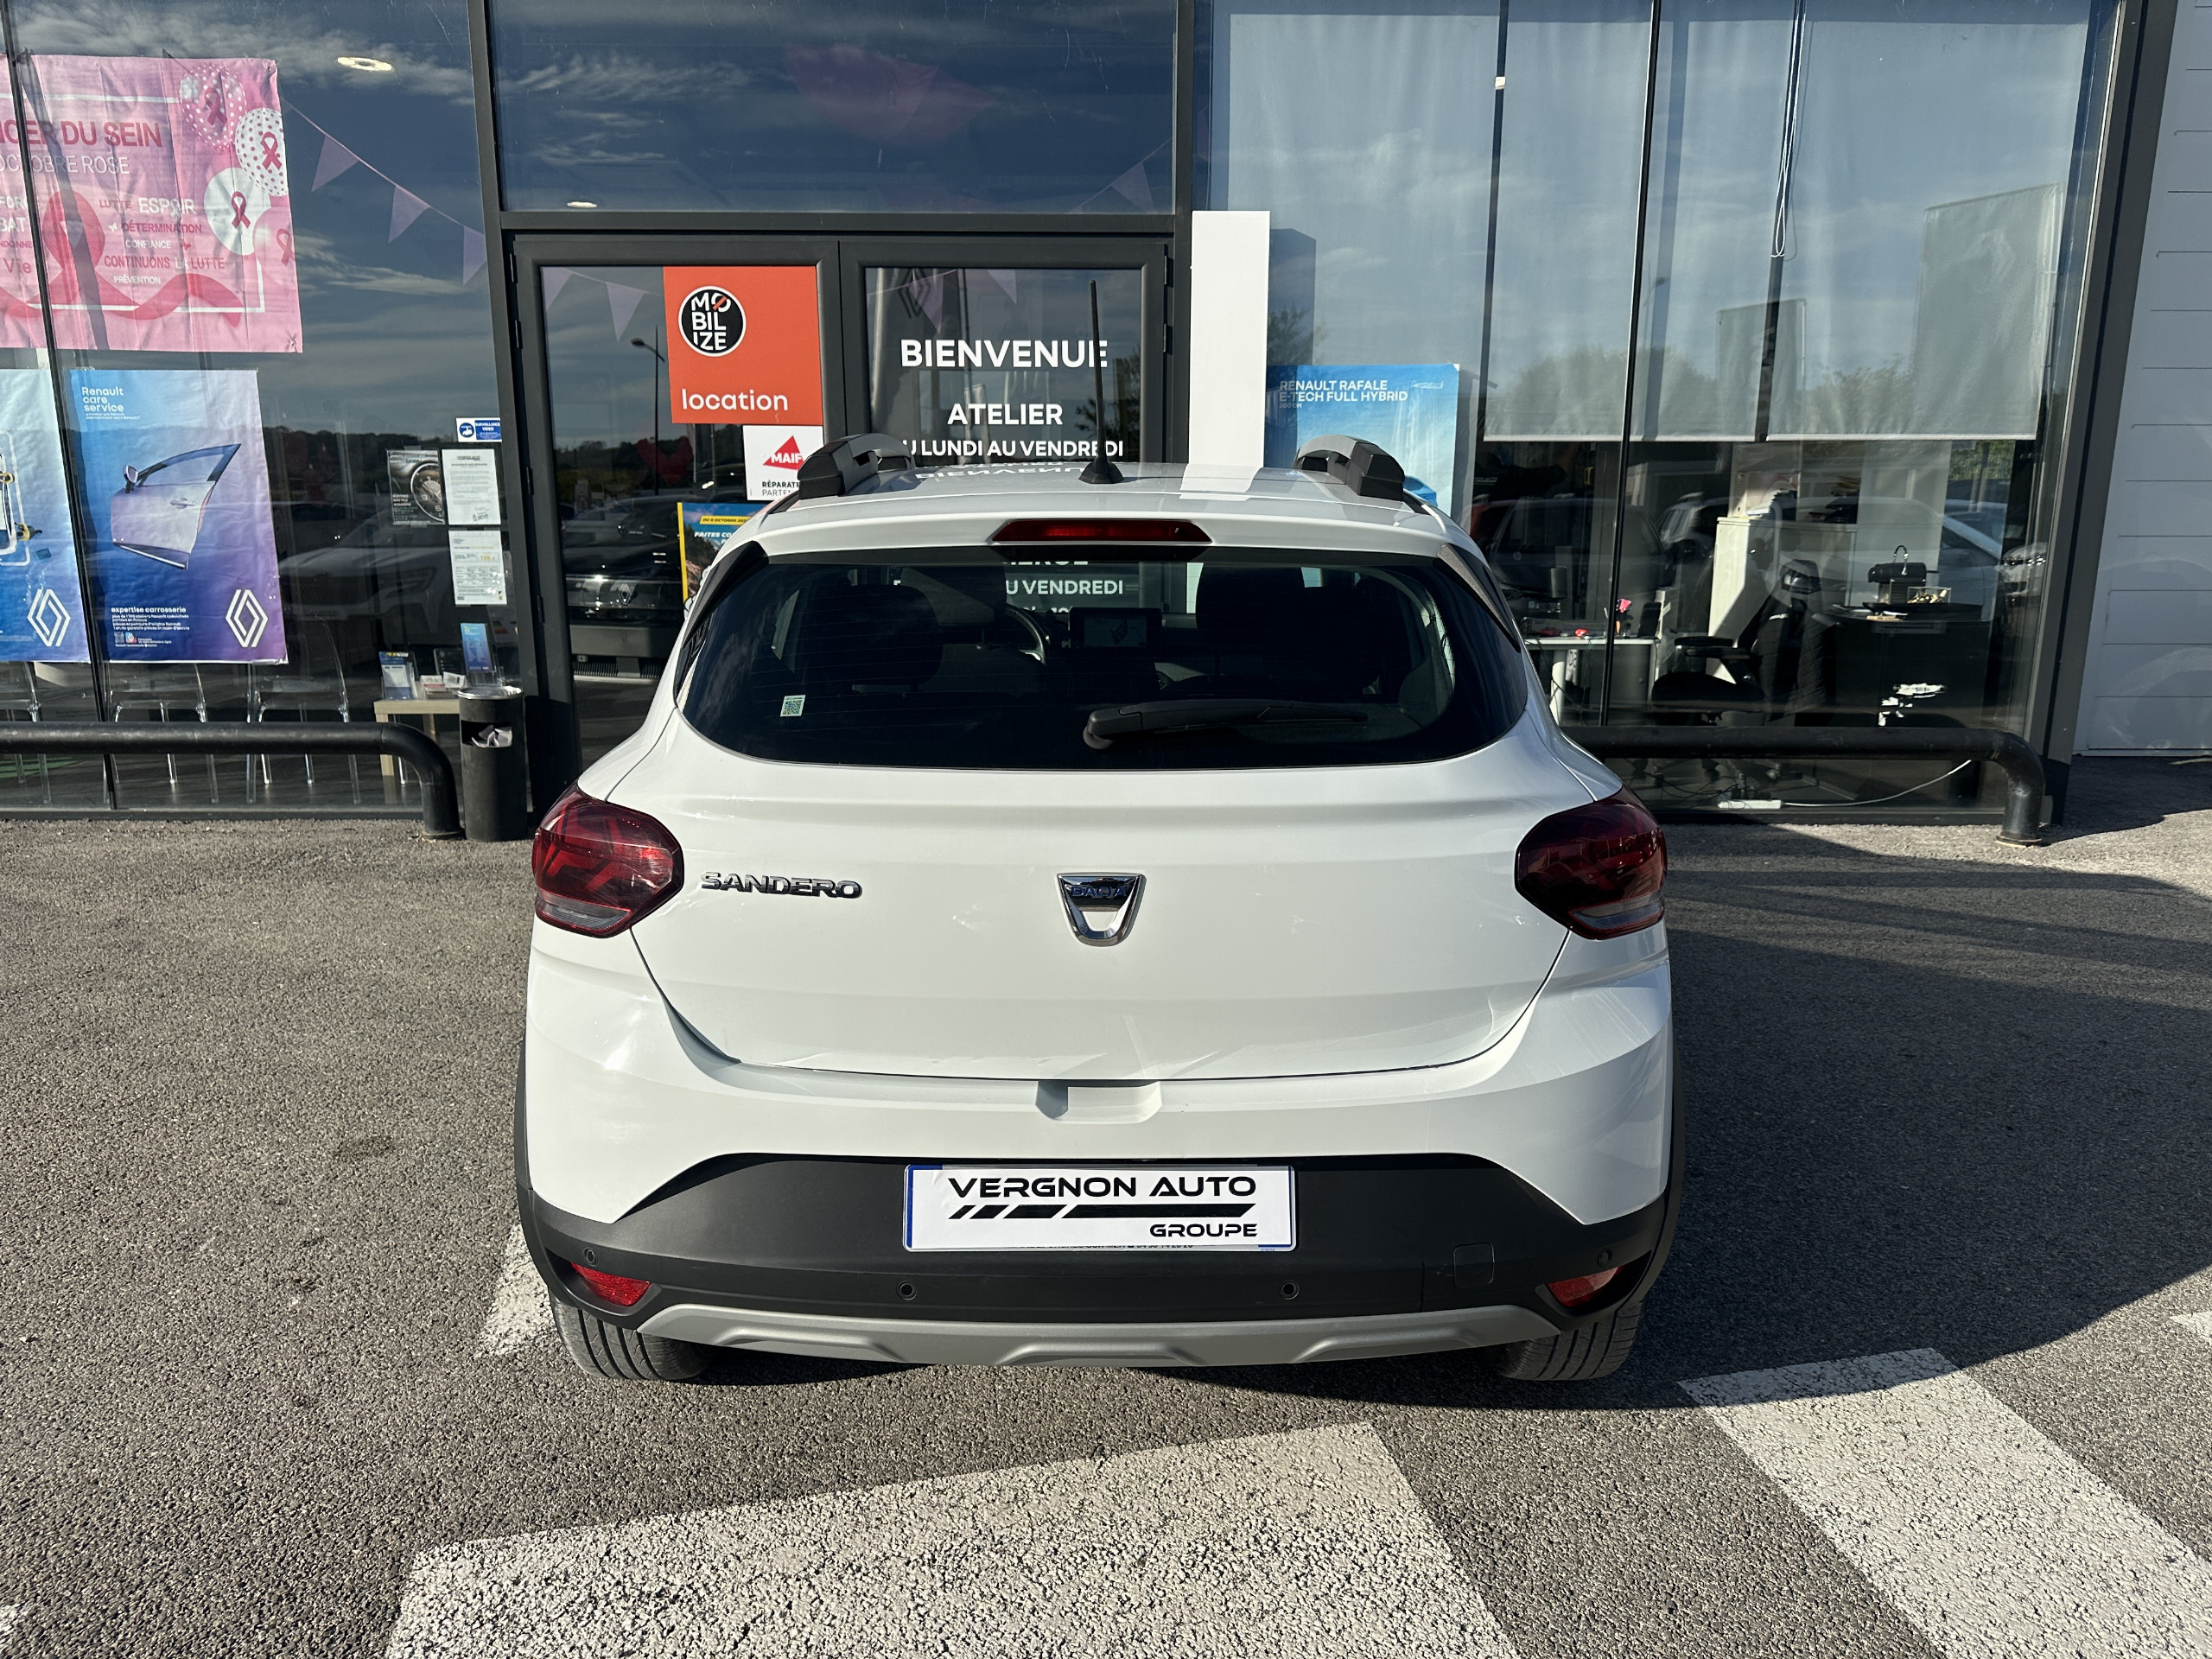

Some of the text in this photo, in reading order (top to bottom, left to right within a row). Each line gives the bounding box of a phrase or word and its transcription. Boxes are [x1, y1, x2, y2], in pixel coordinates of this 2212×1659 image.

[0, 119, 162, 148] CER DU SEIN
[0, 155, 130, 175] OCOBRE ROSE
[99, 197, 197, 215] LUTTE ESPOIR
[123, 219, 202, 233] DÉTERMINATION
[125, 238, 171, 249] CONFIANCE
[104, 255, 170, 269] CONTINUONS
[191, 257, 225, 270] LUTTE
[114, 273, 161, 284] PRÉVENTION
[900, 340, 1108, 368] BIENVENUE
[81, 386, 124, 396] Renault
[1280, 379, 1388, 391] RENAULT RAFALE
[82, 396, 108, 404] care
[681, 388, 789, 411] location
[1280, 391, 1408, 403] E-TECH FULL HYBRID
[84, 403, 124, 412] service
[948, 404, 1064, 425] ATELIER
[921, 440, 982, 456] LUNDI
[987, 441, 1016, 456] AU
[1020, 440, 1123, 457] VENDREDI
[771, 452, 803, 464] MAIF
[761, 480, 800, 488] RÉPARATE
[1006, 580, 1123, 594] U VENDREDI
[111, 606, 144, 614] expertise
[700, 871, 862, 899] SANDERO
[1071, 886, 1127, 897] DACIA
[947, 1176, 1256, 1198] VERGNON AUTO
[1149, 1224, 1258, 1237] GROUPE
